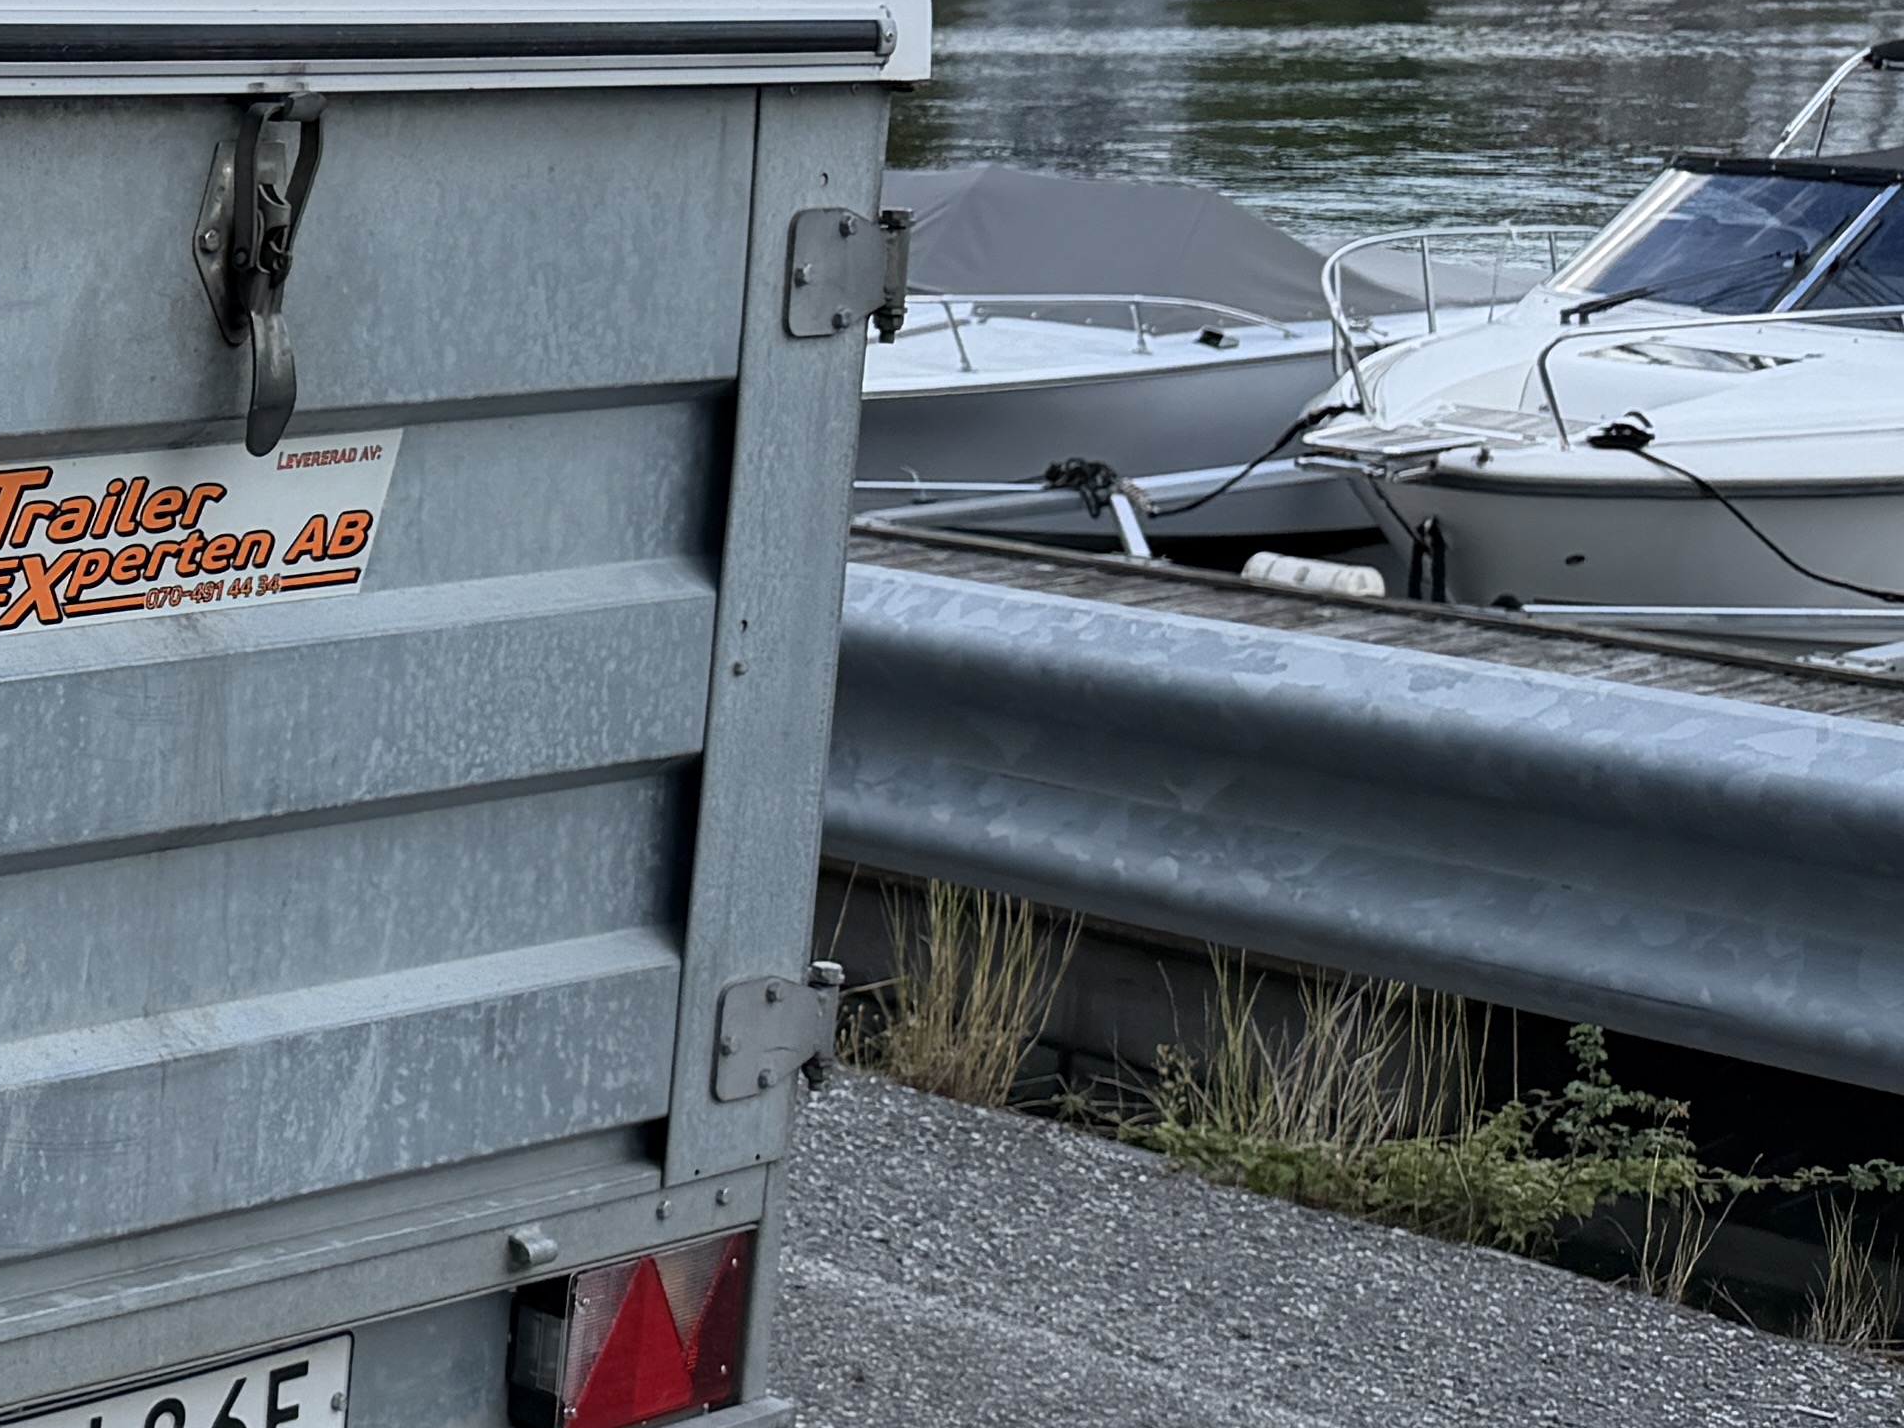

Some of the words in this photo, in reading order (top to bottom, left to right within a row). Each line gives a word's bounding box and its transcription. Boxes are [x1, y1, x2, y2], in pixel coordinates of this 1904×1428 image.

[276, 447, 358, 471] LEVERERAD
[282, 509, 374, 564] AB
[144, 579, 225, 610] 070-491
[226, 575, 254, 599] 44
[254, 573, 282, 597] 34
